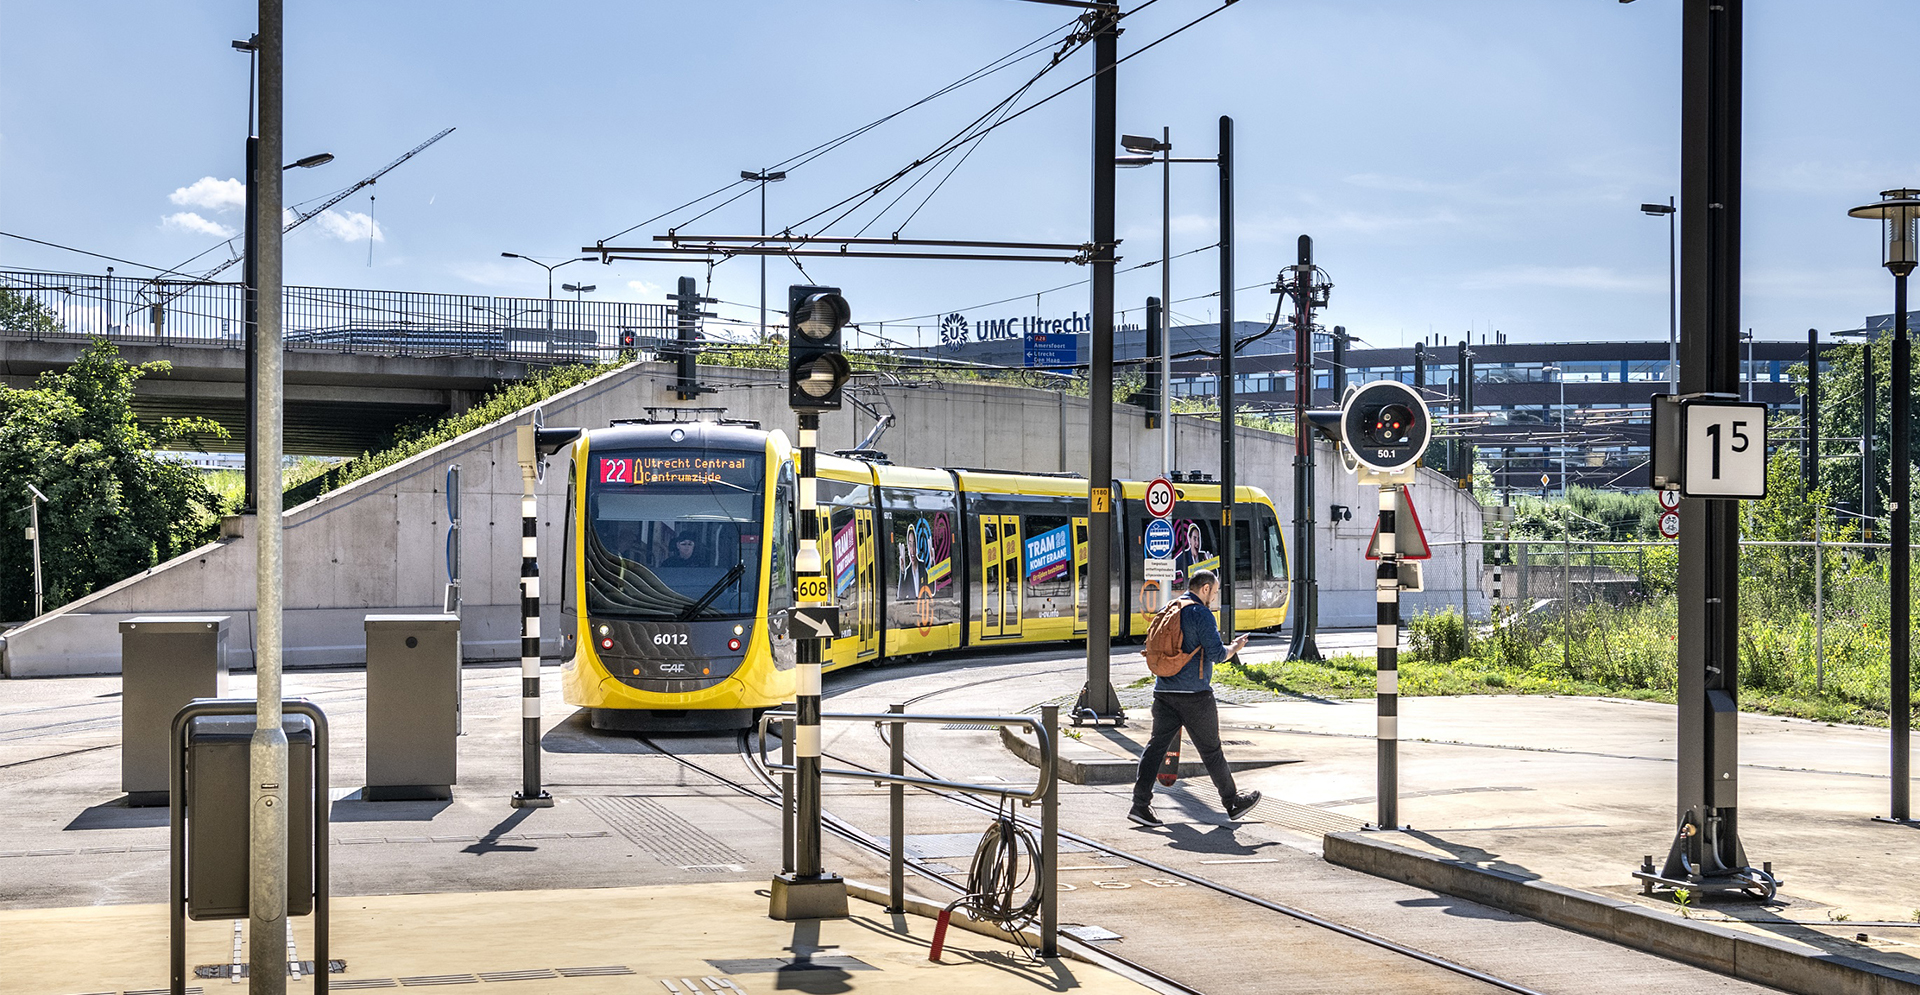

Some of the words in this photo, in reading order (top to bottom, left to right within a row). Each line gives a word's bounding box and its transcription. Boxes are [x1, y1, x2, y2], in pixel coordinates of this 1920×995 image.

[976, 318, 1018, 341] UMC
[1023, 311, 1090, 334] Utrecht
[1378, 450, 1396, 458] 50.1
[606, 460, 626, 482] 22
[644, 458, 690, 468] Utrecht
[695, 458, 745, 468] Centraal
[644, 472, 721, 484] Centrumzijde
[1151, 491, 1169, 504] 30
[1028, 534, 1055, 558] TRAM
[1030, 556, 1046, 570] KOMT
[1047, 547, 1067, 564] ERAAN!
[800, 582, 827, 596] 608
[654, 634, 688, 645] 6012
[660, 664, 684, 672] CAF
